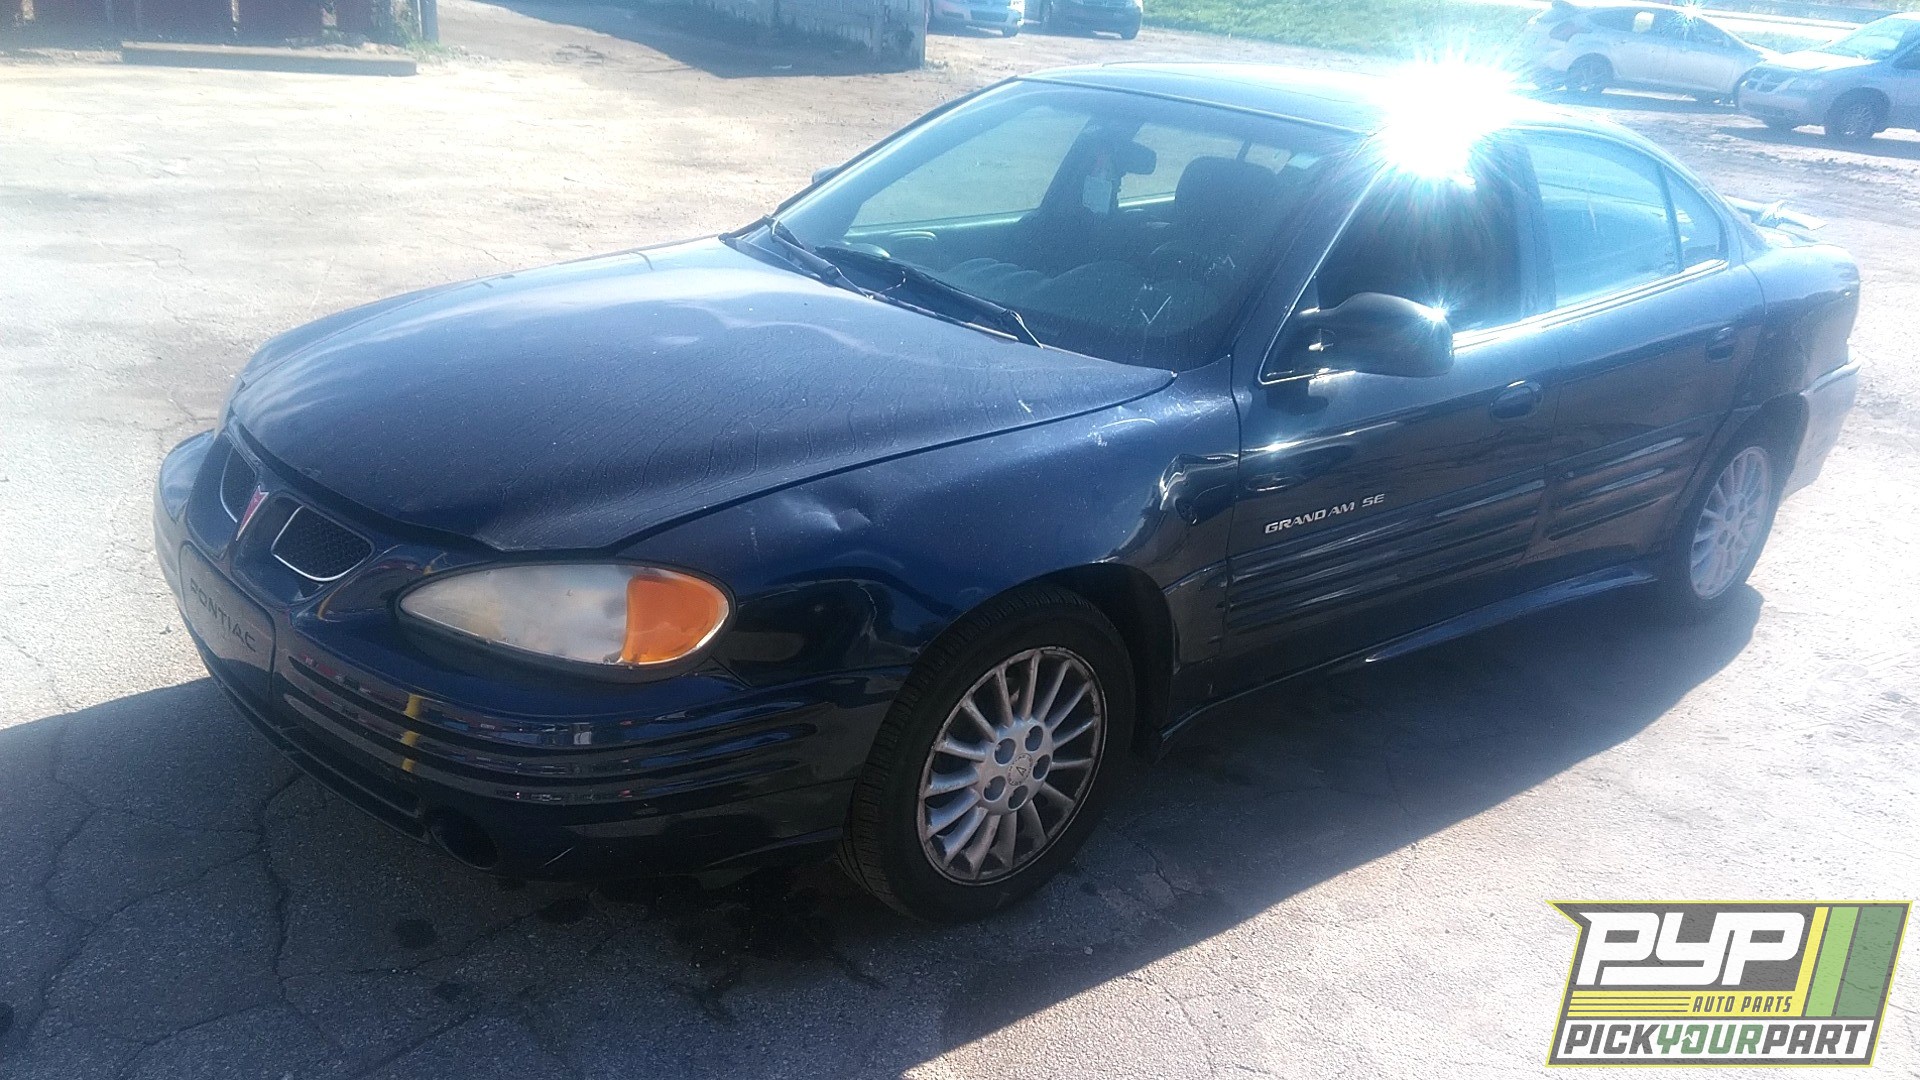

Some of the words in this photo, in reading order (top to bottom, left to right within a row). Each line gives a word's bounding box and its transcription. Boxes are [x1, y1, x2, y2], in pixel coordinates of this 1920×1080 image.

[1264, 508, 1327, 534] GRAND
[1327, 501, 1356, 518] AM
[1361, 493, 1385, 507] SE
[189, 577, 257, 653] PONTIAC
